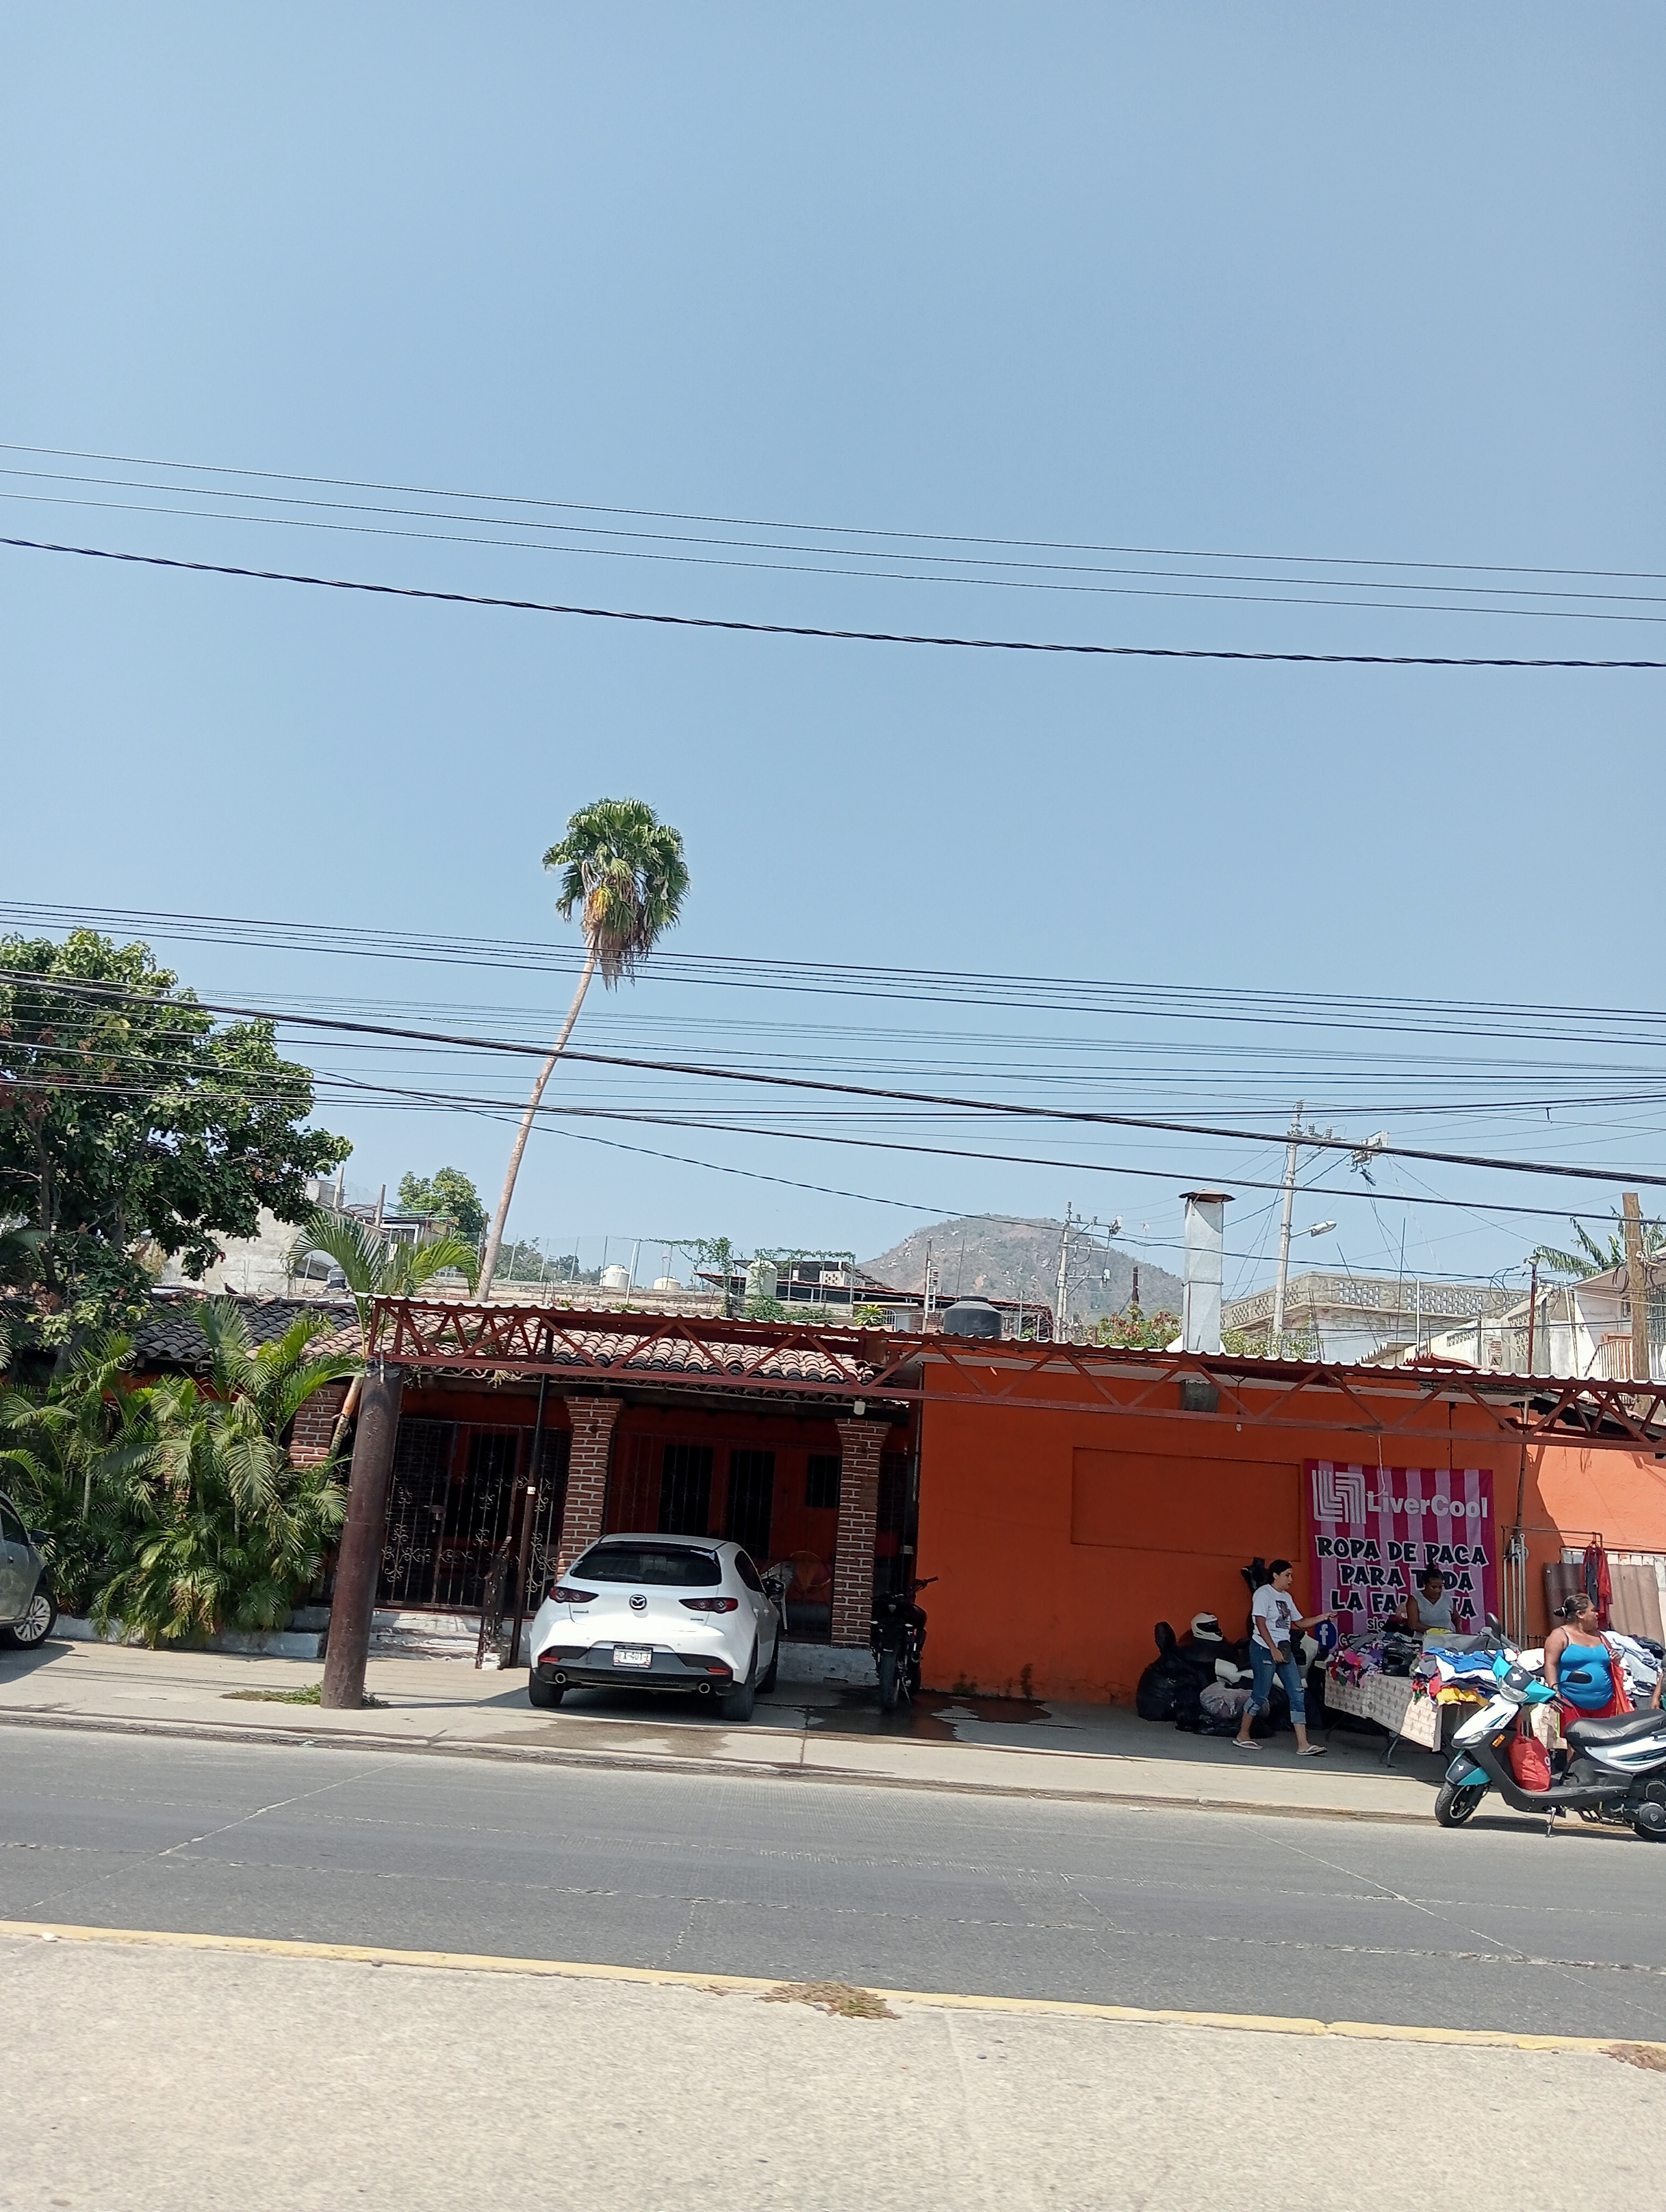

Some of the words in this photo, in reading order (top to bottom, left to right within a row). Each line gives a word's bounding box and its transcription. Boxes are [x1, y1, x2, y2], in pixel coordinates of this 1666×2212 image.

[1367, 1490, 1488, 1518] LiverCool
[1315, 1535, 1382, 1561] ROPA
[1386, 1540, 1419, 1564] DE
[1423, 1542, 1490, 1567] PACA
[1338, 1563, 1406, 1590] PARA
[1409, 1567, 1476, 1593] TDA
[1330, 1589, 1365, 1613] LA
